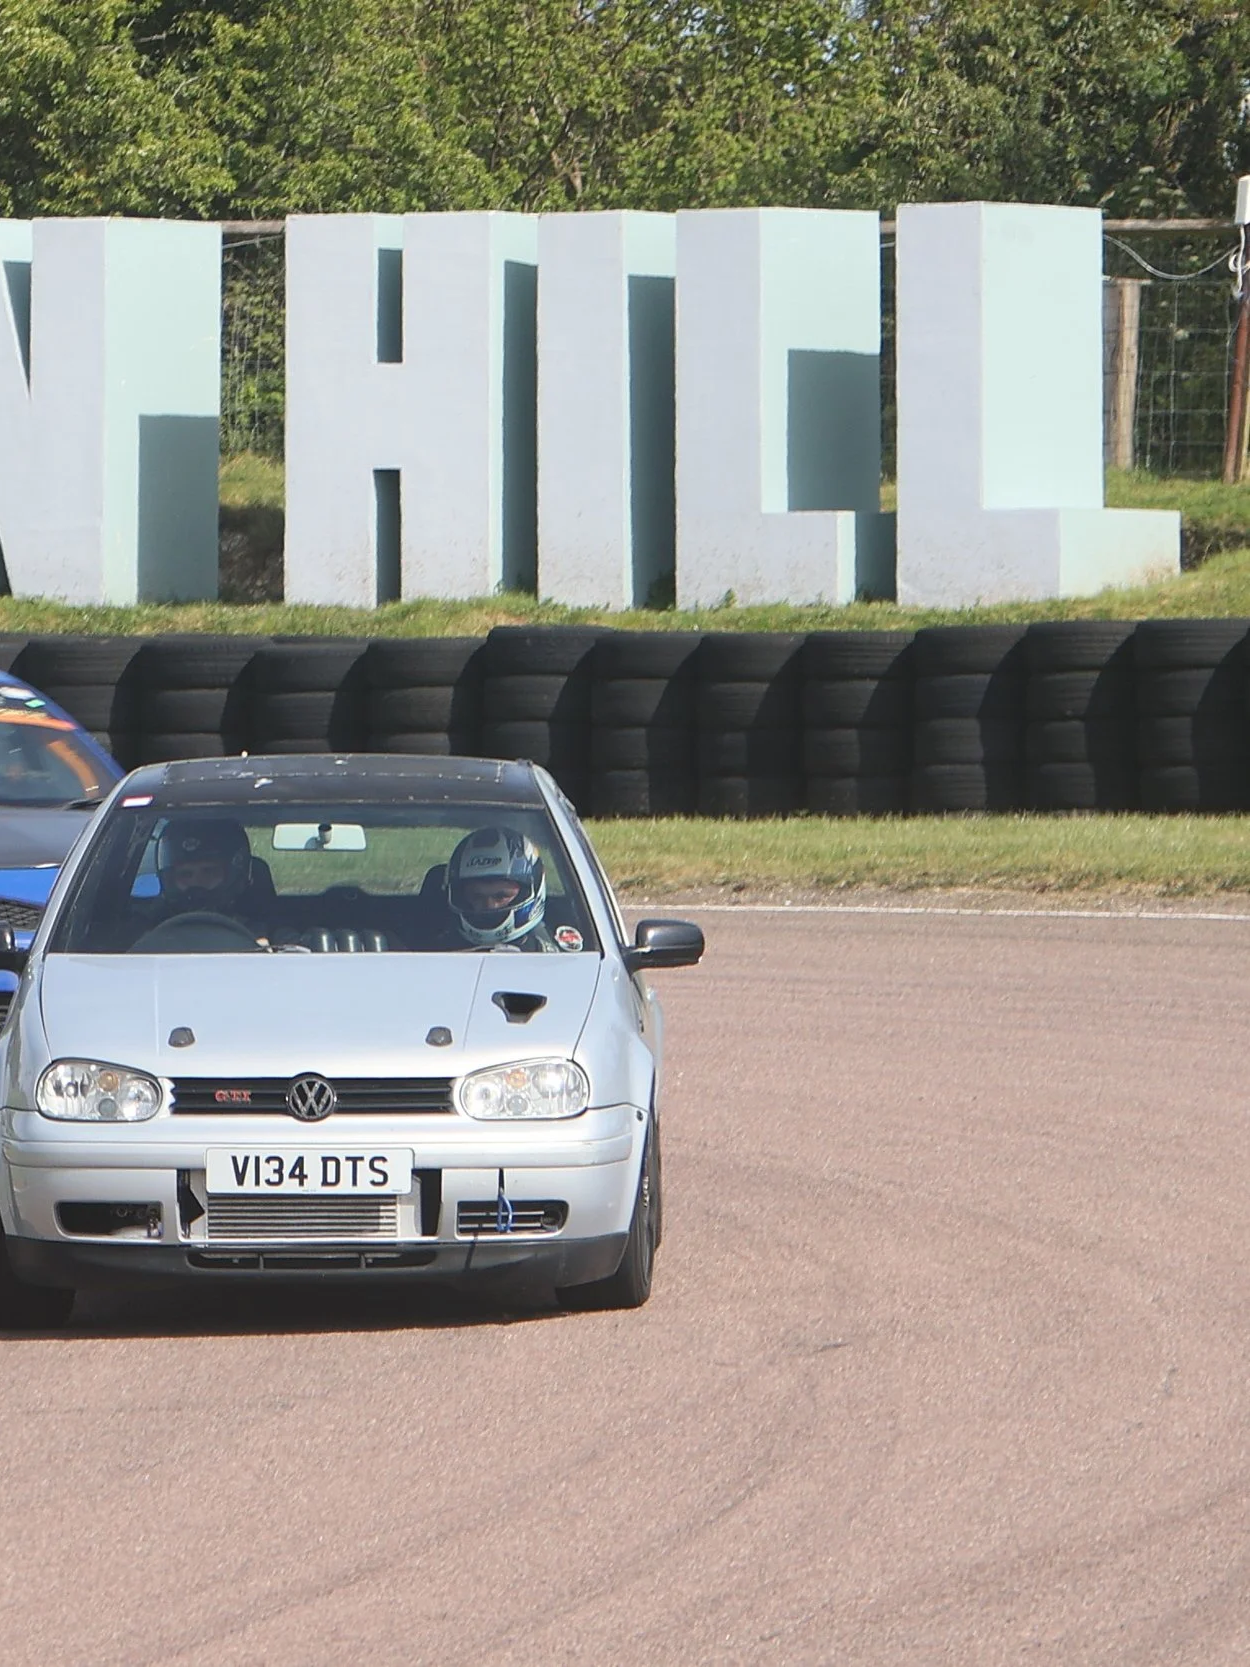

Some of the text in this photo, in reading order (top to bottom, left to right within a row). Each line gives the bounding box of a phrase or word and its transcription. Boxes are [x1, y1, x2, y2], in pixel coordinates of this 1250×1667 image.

[285, 202, 1150, 609] HILL
[231, 1155, 389, 1187] V134 DTS
